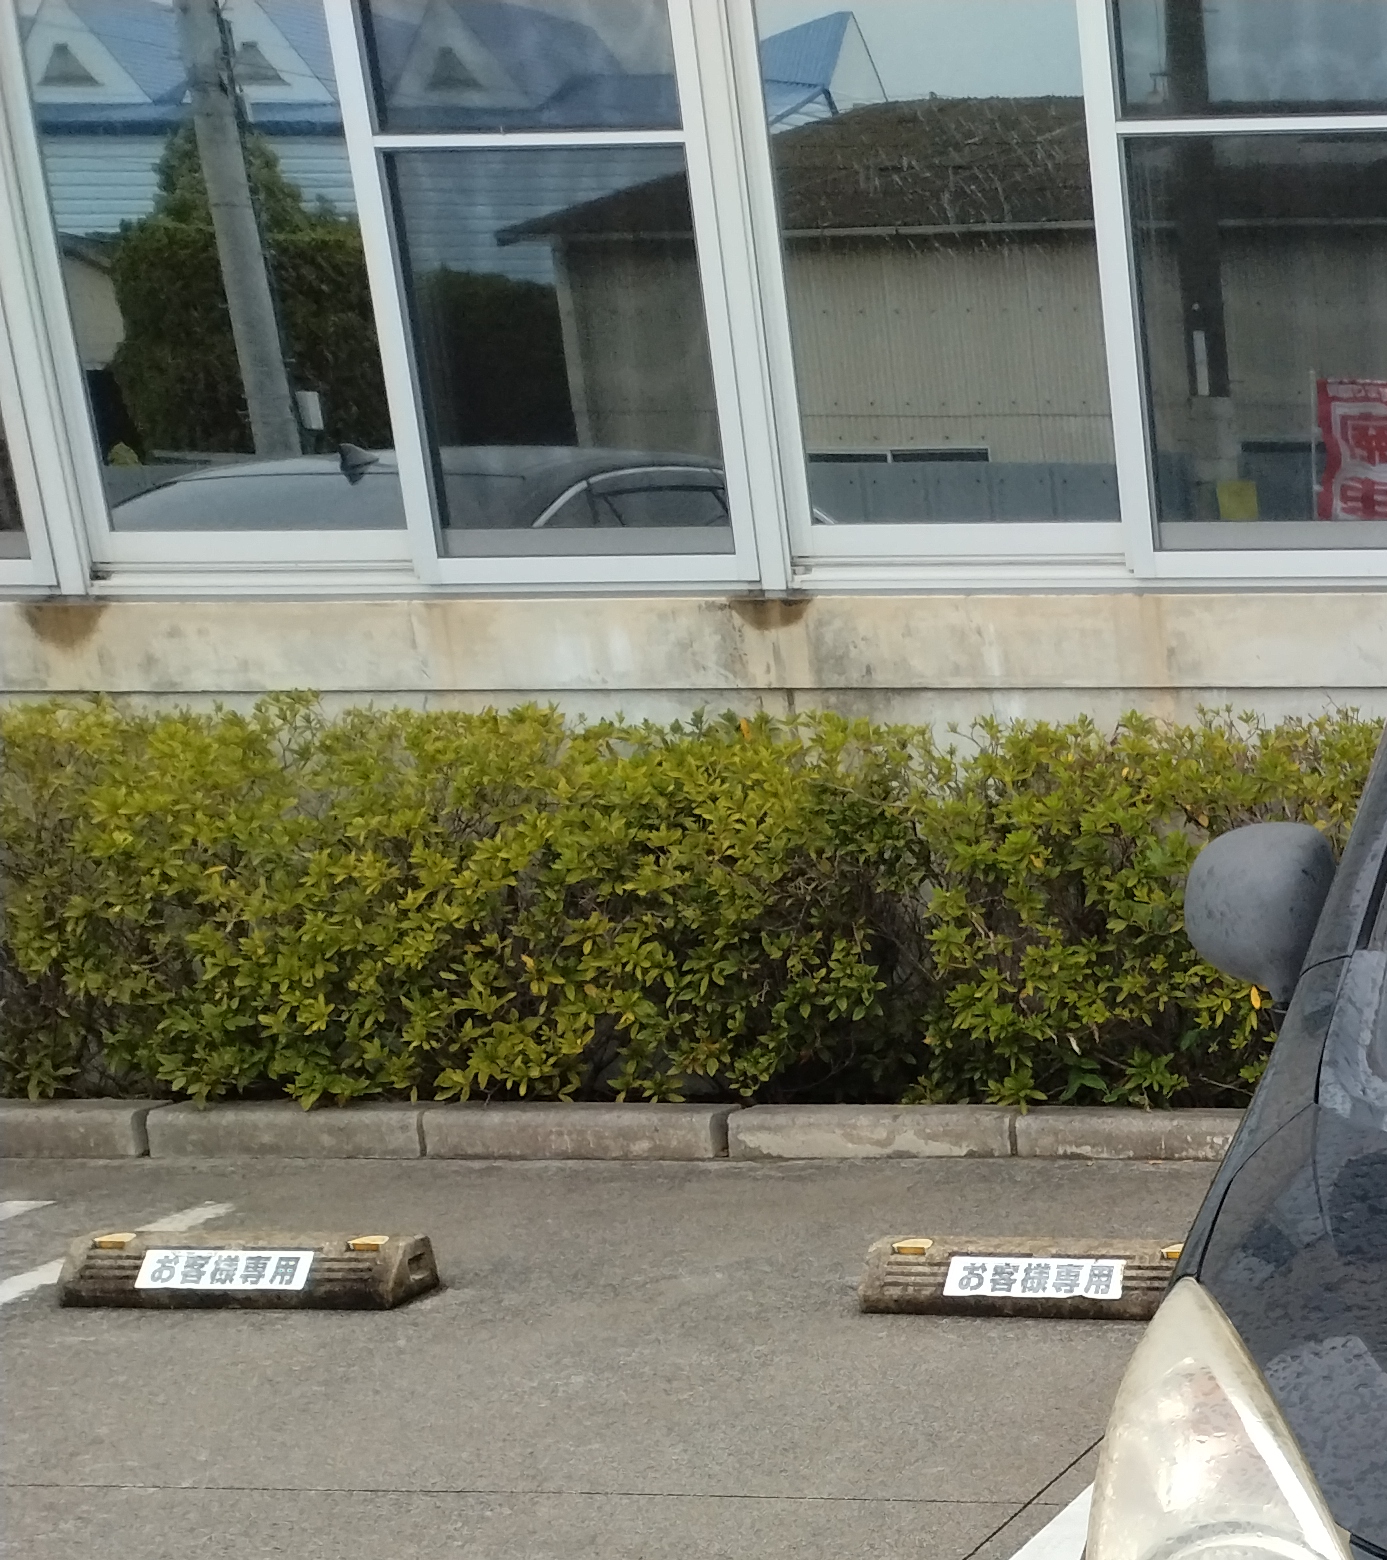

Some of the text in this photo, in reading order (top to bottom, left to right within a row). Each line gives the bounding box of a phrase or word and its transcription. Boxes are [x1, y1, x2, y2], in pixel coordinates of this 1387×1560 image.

[149, 1254, 305, 1286] お客様専用
[957, 1262, 1116, 1296] お客様専用
